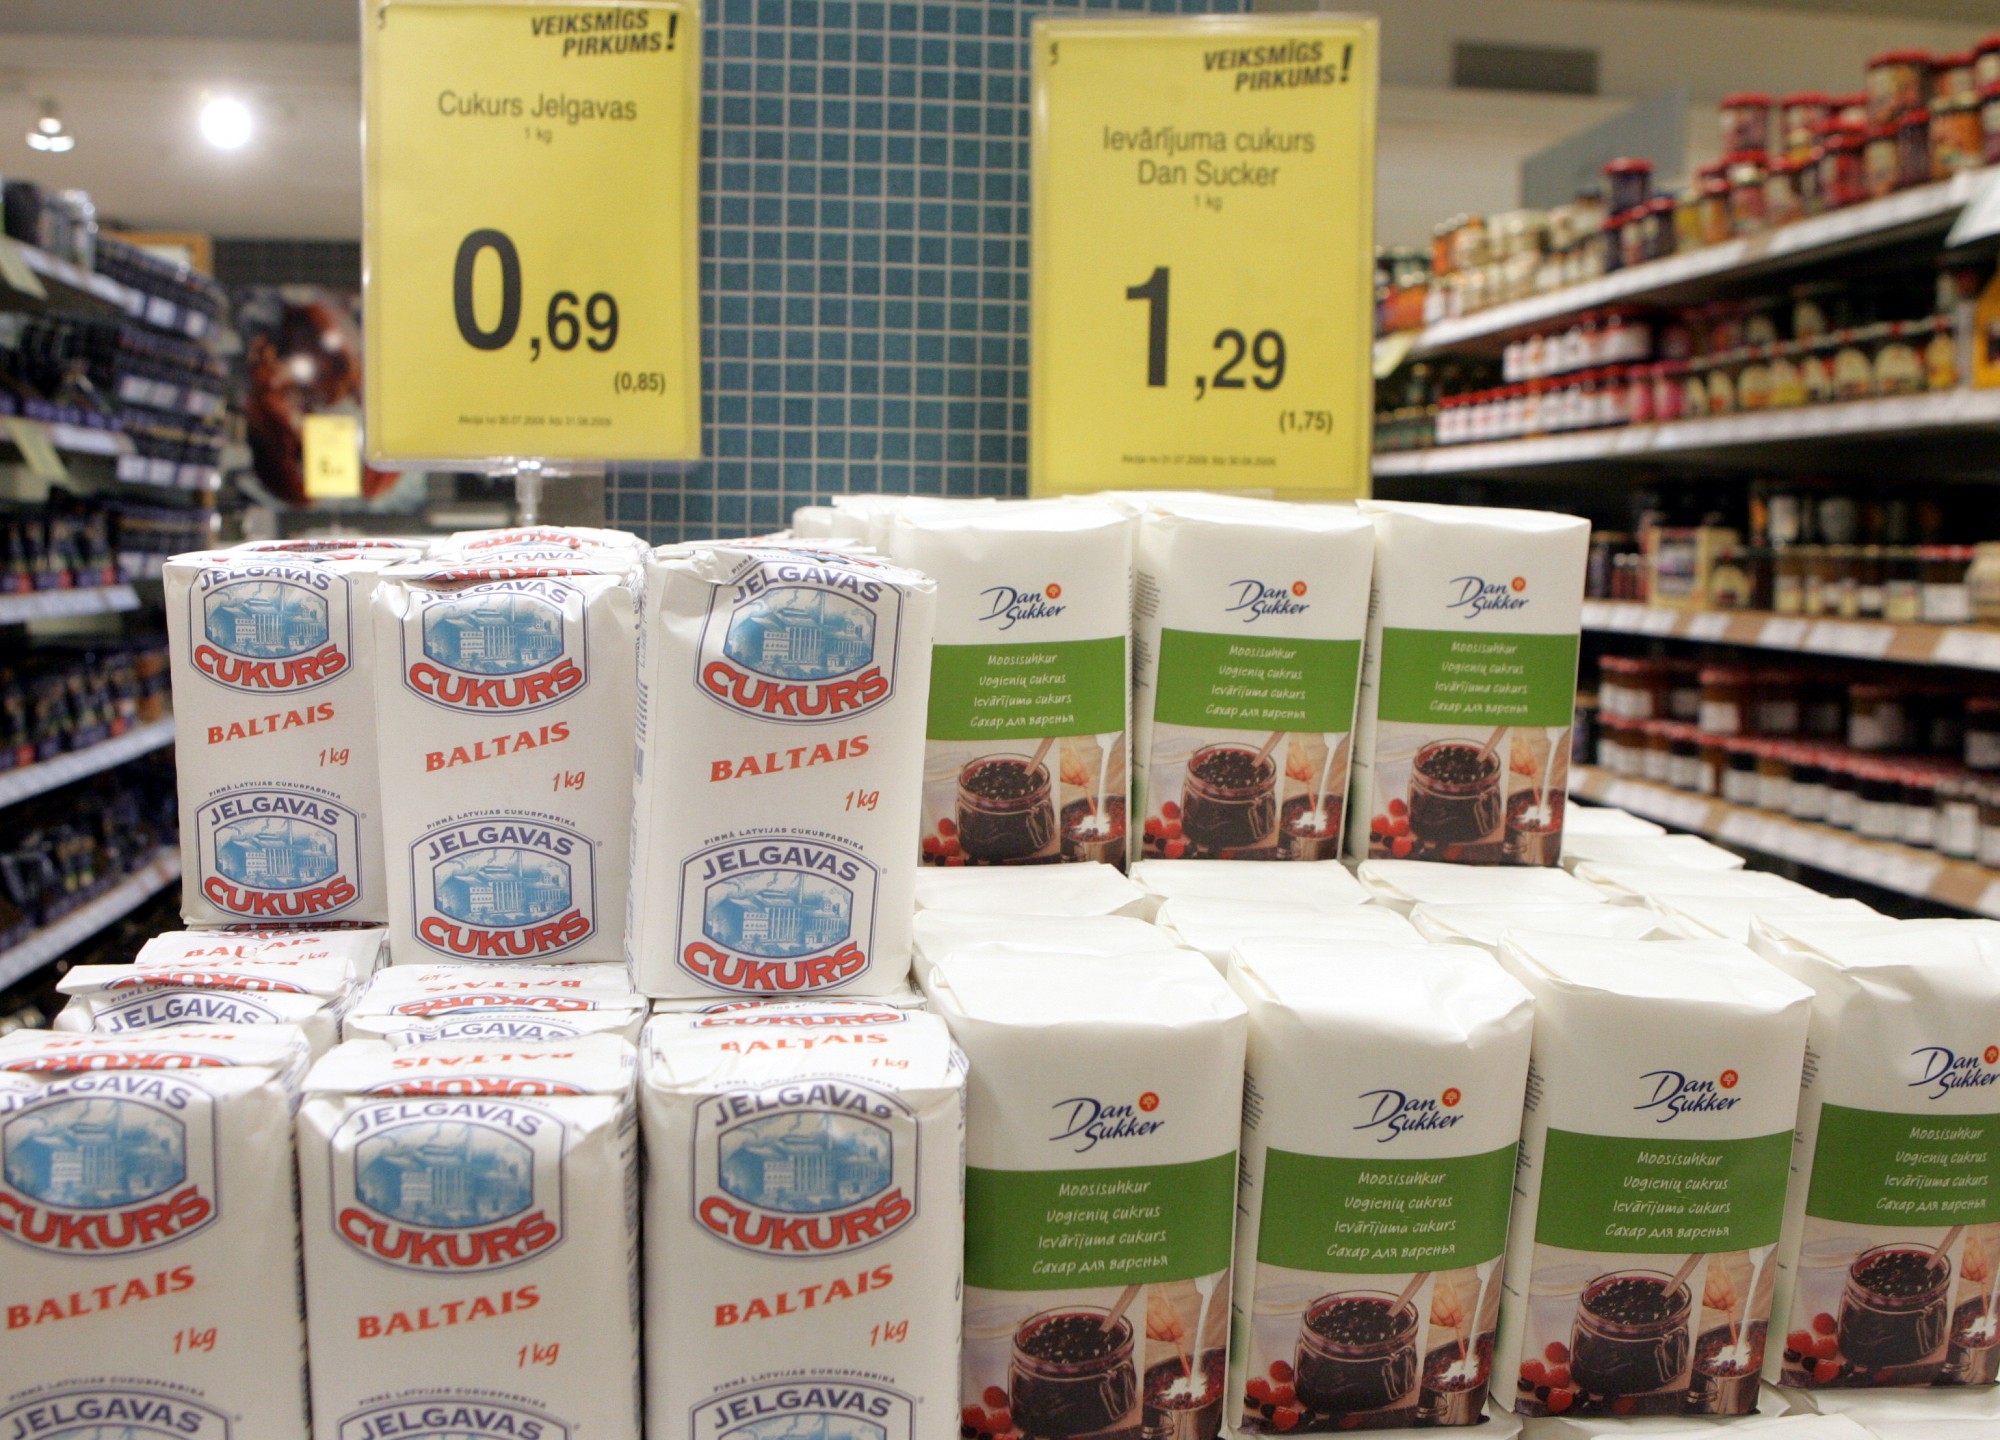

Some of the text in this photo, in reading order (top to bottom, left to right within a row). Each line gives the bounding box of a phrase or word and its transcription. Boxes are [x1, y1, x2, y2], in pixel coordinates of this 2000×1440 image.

[531, 9, 649, 38] VEIKSMĪGS
[1204, 39, 1323, 71] VEIKSMĪGS
[438, 90, 637, 124] Cukurs Jelgavas
[524, 126, 553, 144] 1 kg
[1103, 126, 1315, 161] Ievārījuma cukurs
[1138, 160, 1280, 187] Dan Sucker
[1194, 195, 1222, 213] 1 kg
[453, 228, 620, 363] 0,69
[1125, 266, 1287, 401] 1,29
[613, 372, 666, 395] (0,85)
[1279, 410, 1333, 435] (1,75)
[201, 567, 333, 591] JELGAVAS
[421, 580, 568, 604] JELGAVAS
[733, 566, 883, 604] JELGAVAS
[978, 586, 1043, 621] Dan
[1225, 579, 1288, 611] Dan
[998, 602, 1066, 630] Sukker
[1243, 600, 1310, 623] Sukker
[195, 643, 346, 688] CUKURS
[987, 653, 1058, 665] Moosisuhkur
[409, 657, 582, 708] CUKURS
[703, 661, 888, 716] CUKURS
[1029, 673, 1066, 685] cukrus
[974, 694, 1072, 710] Ievārījuma cukurs
[207, 702, 335, 744] BALTAIS
[970, 714, 1074, 729] Сахар для варенья
[319, 747, 350, 767] 1 kg
[425, 721, 570, 772] BALTAIS
[710, 735, 870, 782] BALTAIS
[552, 771, 585, 792] 1 kg
[210, 796, 340, 826] JELGAVAS
[845, 789, 880, 812] 1 kg
[457, 809, 501, 819] LATVIJAS
[504, 809, 576, 827] CUKURFABRIKA
[428, 826, 575, 861] JELGAVAS
[704, 827, 864, 851] PIRMĀ LATVIJAS CUKURFABRIKA
[702, 846, 860, 882] JELGAVAS
[204, 875, 355, 916] CUKURS
[420, 909, 590, 956] CUKURS
[683, 940, 866, 991] CUKURS
[425, 980, 582, 993] BALTAIS
[398, 995, 589, 1016] CUKURS
[885, 1058, 910, 1069] kg
[1908, 1046, 1980, 1086] Dan
[1633, 1070, 1715, 1110] Dan
[1928, 1069, 2000, 1100] Sukker
[354, 1101, 543, 1137] JELGAVAS
[1049, 1097, 1134, 1141] Dan
[1353, 1089, 1437, 1130] Dan
[1656, 1092, 1741, 1124] Sukker
[1074, 1117, 1165, 1153] Sukker
[1377, 1111, 1464, 1143] Sukker
[1909, 1126, 1984, 1140] Moosisuhkur
[1637, 1151, 1723, 1166] Moosisuhkur
[1950, 1152, 1987, 1163] cukrus
[1058, 1180, 1151, 1197] Moosisuhkur
[1358, 1172, 1446, 1185] Moosisuhkur
[1685, 1177, 1729, 1190] cukrus
[1885, 1174, 1989, 1189] Ievārījuma cukurs
[1113, 1205, 1161, 1220] cukrus
[1408, 1196, 1453, 1210] cukrus
[1613, 1200, 1731, 1216] Ievārījuma cukurs
[1876, 1197, 1986, 1213] Сахар для варенья
[699, 1188, 912, 1251] CUKURS
[1335, 1220, 1456, 1236] Ievārījuma cukurs
[1605, 1223, 1730, 1240] Сахар для варенья
[339, 1208, 557, 1267] CUKURS
[1038, 1230, 1167, 1253] Ievārījuma cukurs
[1327, 1243, 1456, 1260] Сахар для варенья
[1032, 1255, 1168, 1276] Сахар для варенья
[6, 1265, 196, 1331] BALTAIS
[714, 1264, 894, 1327] BALTAIS
[357, 1285, 541, 1339] BALTAIS
[173, 1327, 217, 1354] 1 kg
[870, 1320, 909, 1347] 1 kg
[517, 1342, 560, 1368] 1 kg
[13, 1399, 204, 1440] JELGAVAS
[714, 1388, 892, 1430] JELGAVAS
[362, 1407, 545, 1440] JELGAVAS
